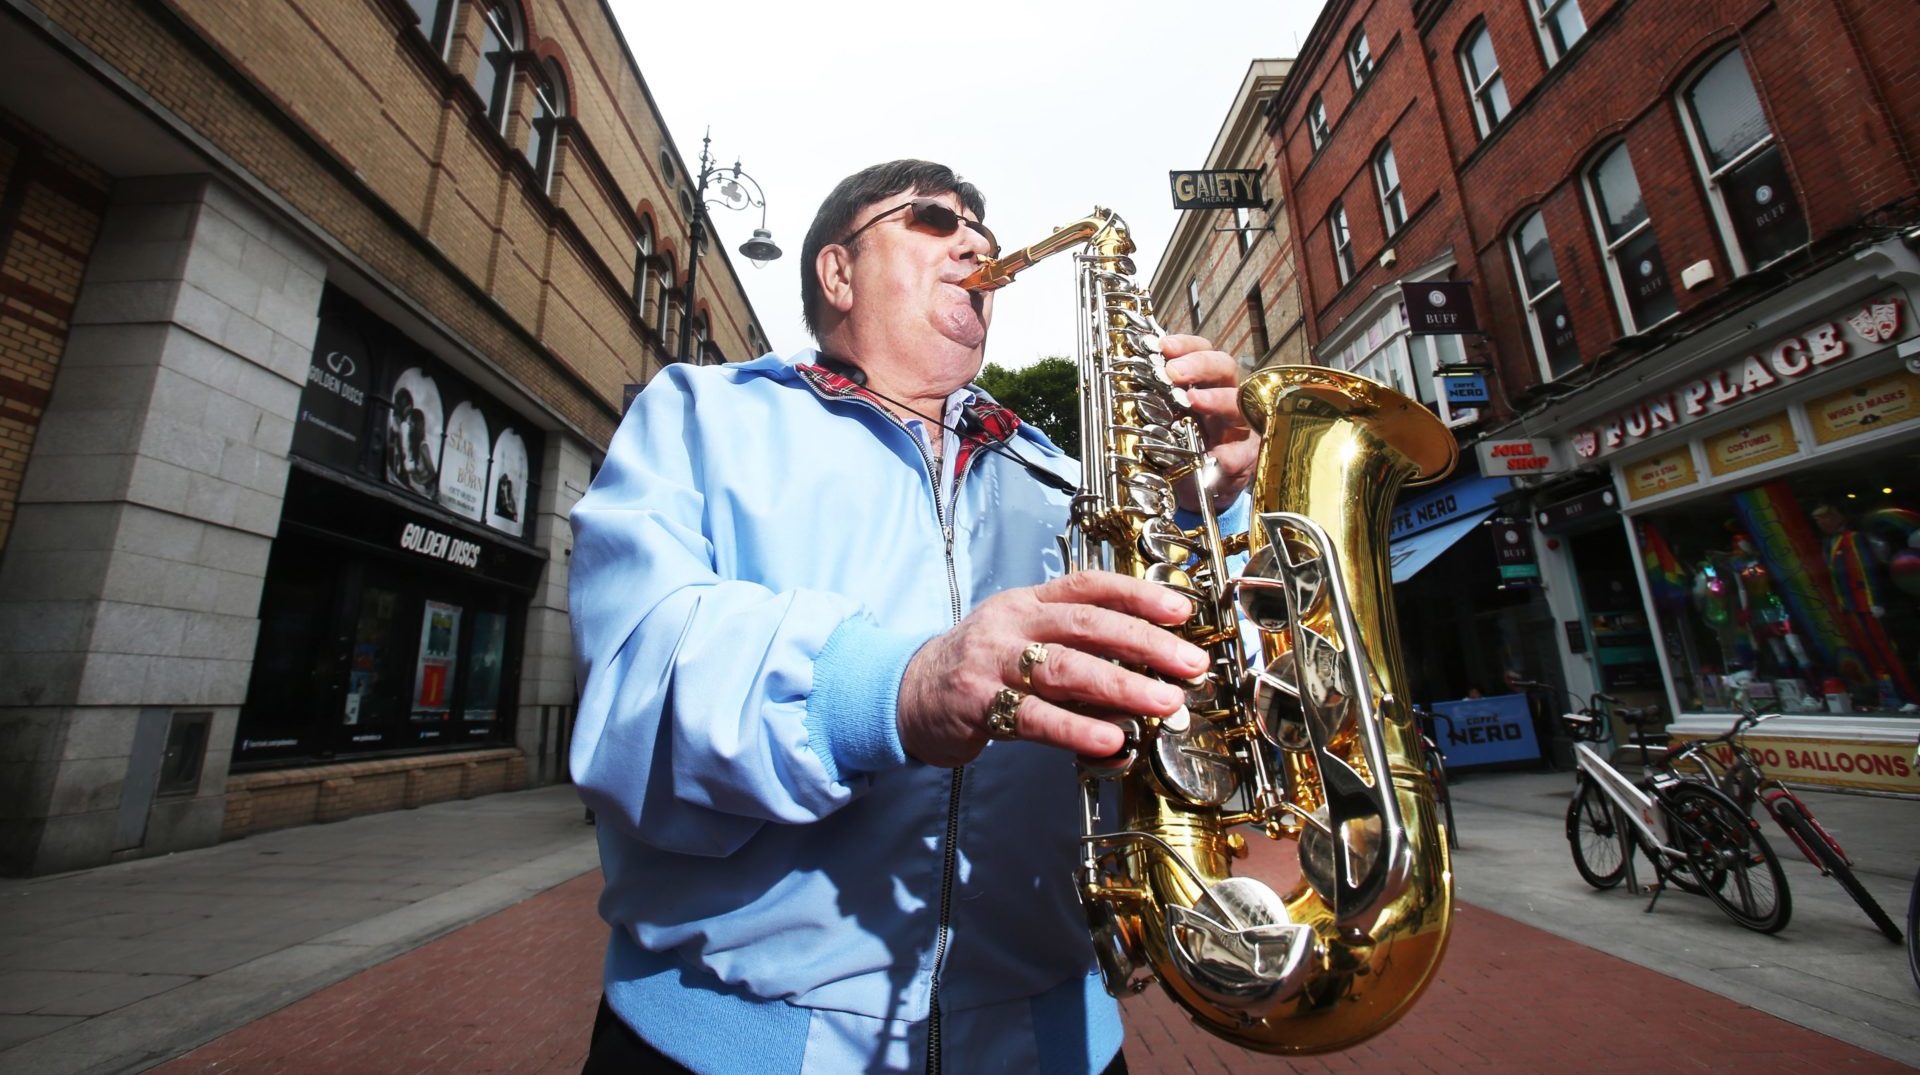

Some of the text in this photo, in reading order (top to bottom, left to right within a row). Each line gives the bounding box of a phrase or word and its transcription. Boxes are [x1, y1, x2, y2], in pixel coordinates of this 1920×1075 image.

[1175, 173, 1255, 202] GAIETY
[1756, 202, 1787, 227] BUFF
[1640, 278, 1663, 296] BUFF
[1426, 313, 1458, 324] BUFF
[308, 365, 364, 407] GOLDEN DISCS
[1449, 388, 1484, 398] NERO
[1605, 321, 1848, 447] FUN PLACE
[1827, 405, 1855, 421] WIGS
[1865, 389, 1906, 408] MASKS
[1491, 443, 1533, 458] JOKE
[1727, 433, 1771, 454] COSTUMES
[1507, 456, 1549, 470] SHOP
[456, 467, 483, 492] BORN
[1416, 494, 1458, 525] NERO
[400, 522, 482, 569] GOLDEN DISCS
[1448, 722, 1523, 747] NERO
[1750, 748, 1780, 768] DO
[1784, 749, 1910, 778] BALLOONS
